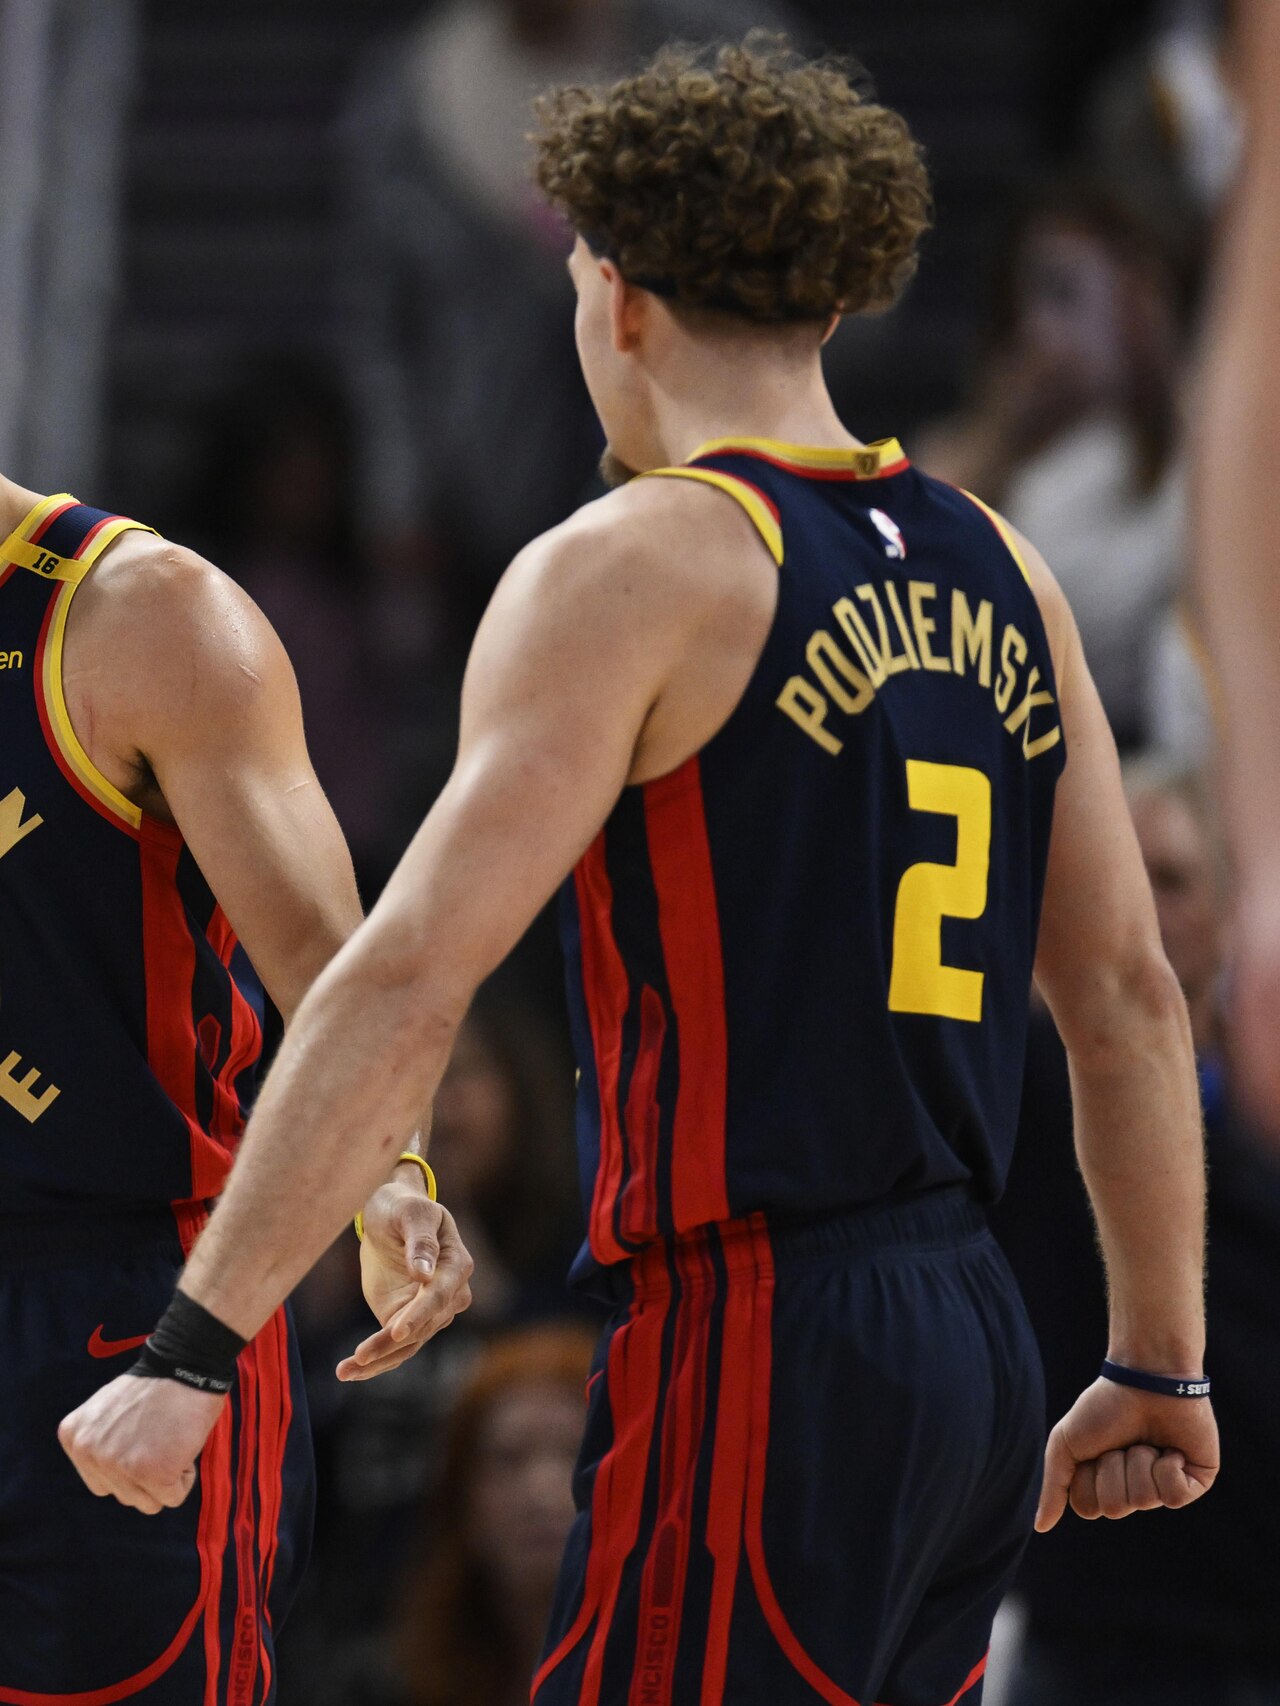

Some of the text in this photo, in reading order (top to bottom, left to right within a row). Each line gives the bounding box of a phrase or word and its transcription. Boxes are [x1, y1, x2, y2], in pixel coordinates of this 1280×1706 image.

[32, 552, 60, 575] 16
[775, 579, 1061, 761] PODZIEMSKI
[887, 758, 991, 1022] 2
[234, 1614, 254, 1706] NCISCO
[639, 1614, 670, 1706] NCISCO
